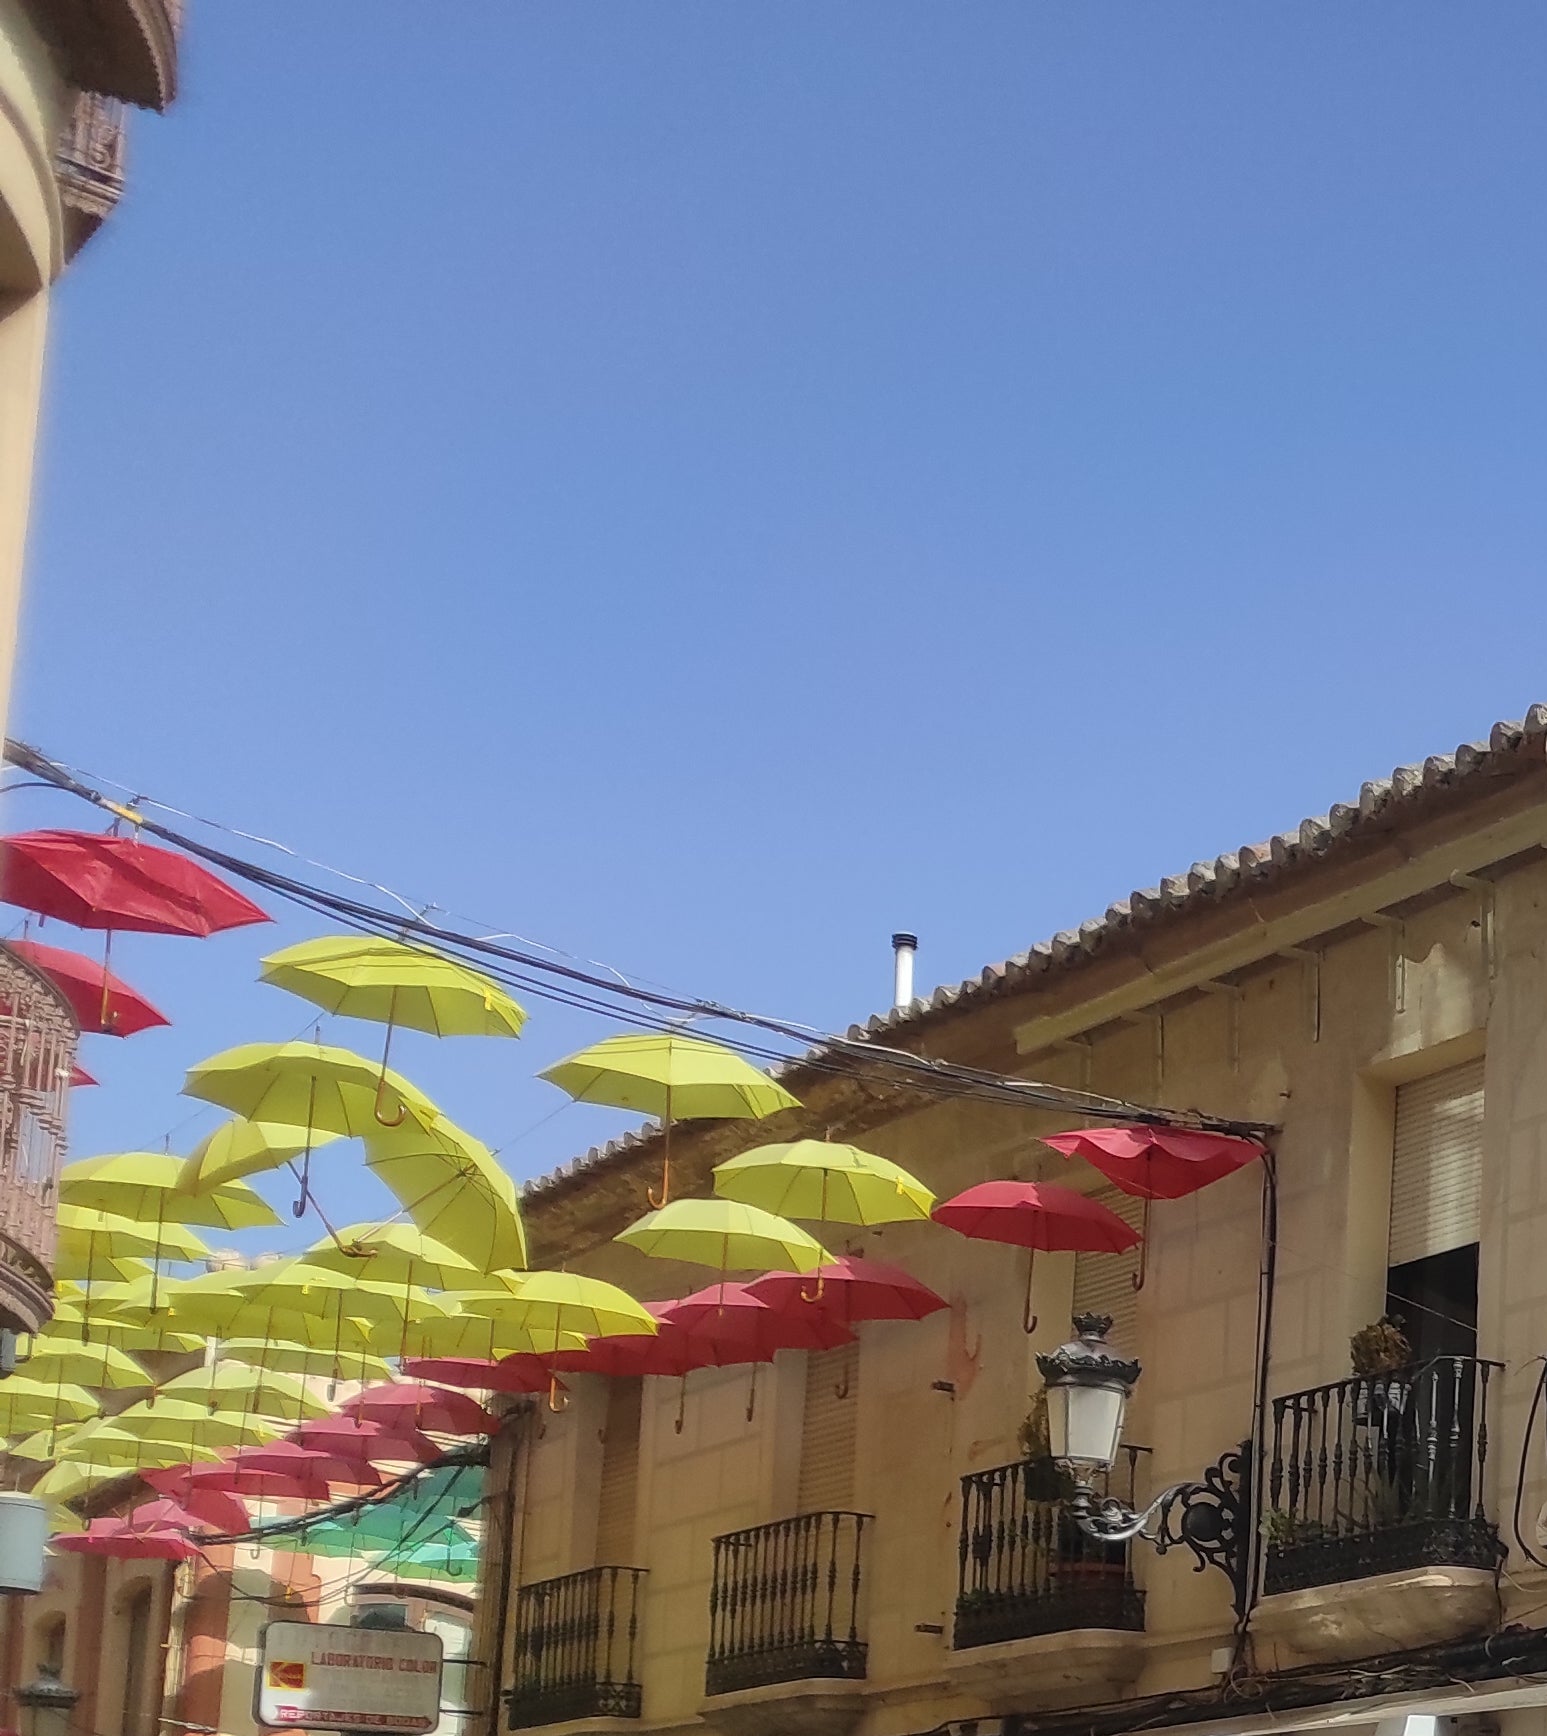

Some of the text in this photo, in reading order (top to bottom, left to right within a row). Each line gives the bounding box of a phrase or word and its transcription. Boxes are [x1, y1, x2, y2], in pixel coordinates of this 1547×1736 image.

[311, 1651, 437, 1674] LABORATORIO COLOR
[279, 1706, 363, 1723] REPORTAJES
